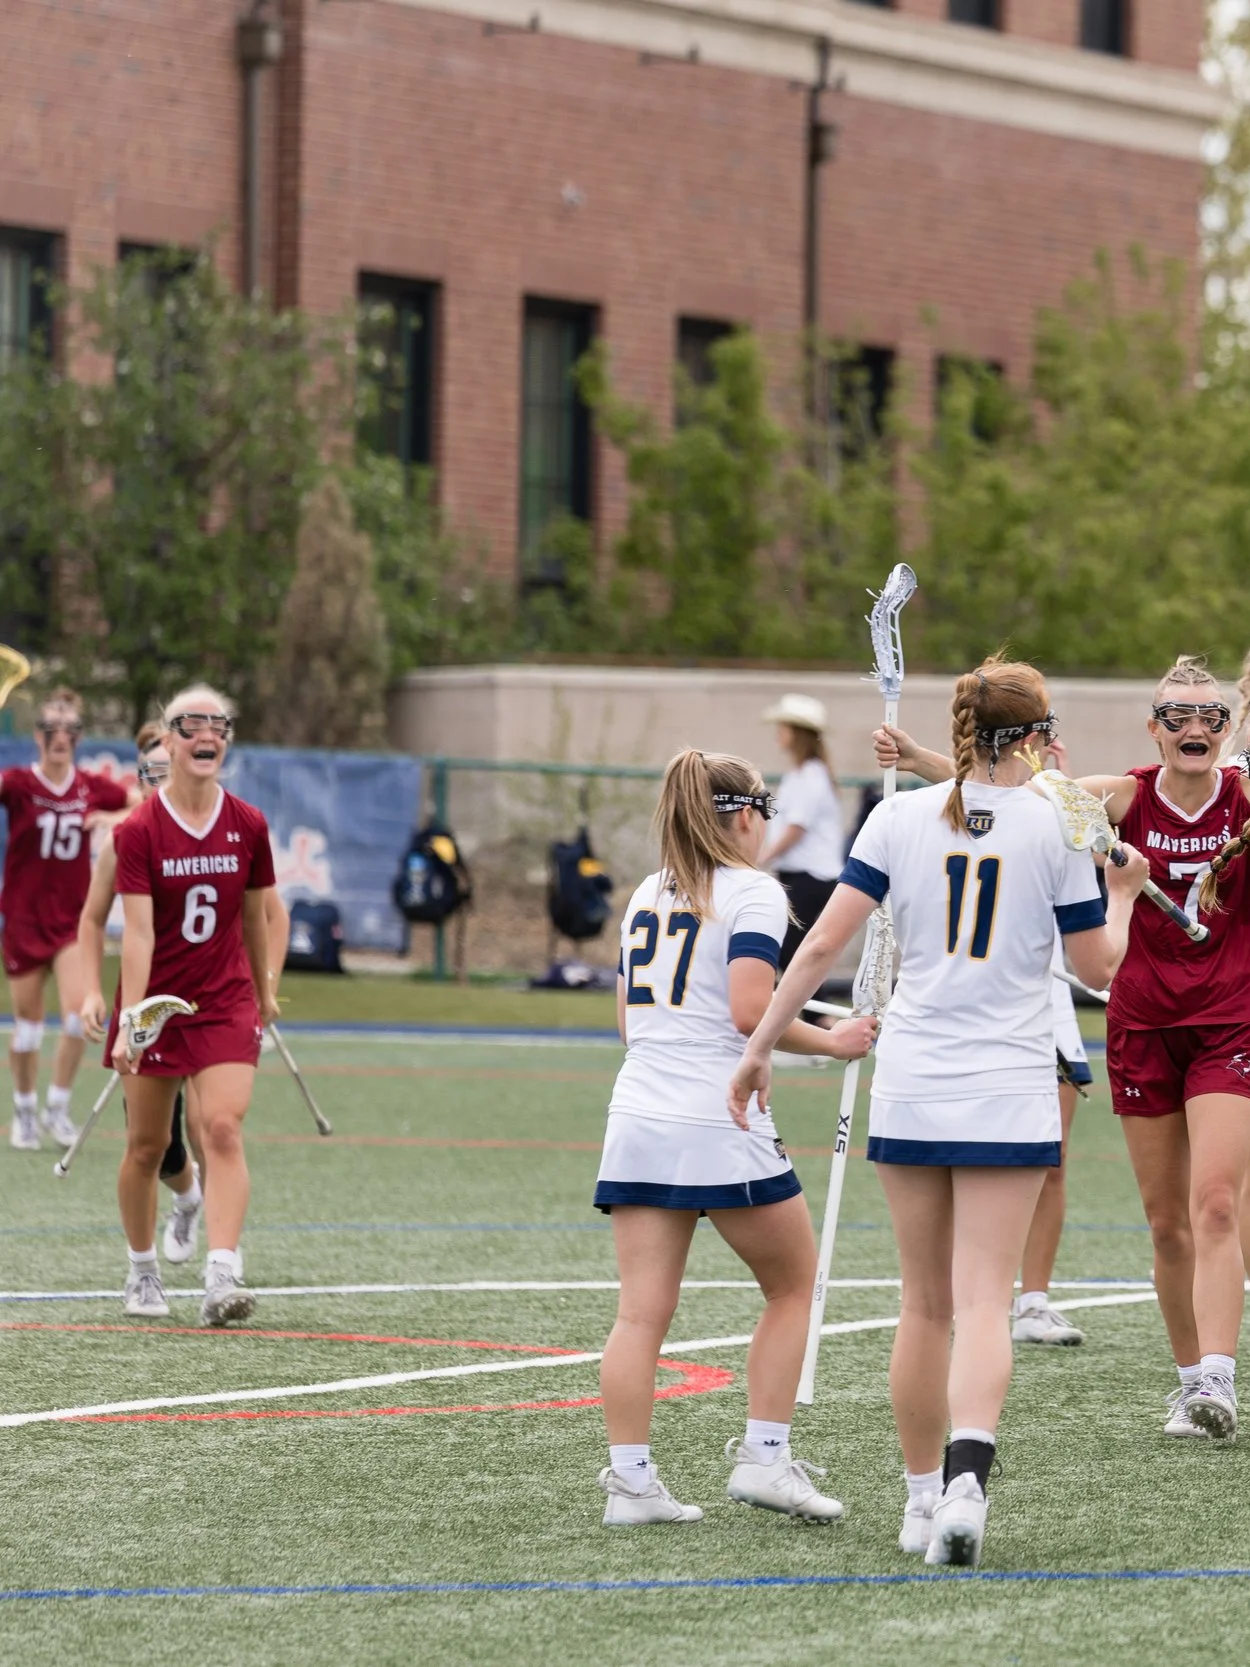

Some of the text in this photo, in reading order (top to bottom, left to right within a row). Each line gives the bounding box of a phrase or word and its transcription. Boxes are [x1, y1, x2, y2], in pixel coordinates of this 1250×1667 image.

[996, 726, 1025, 737] STX
[36, 811, 83, 861] 15
[162, 854, 240, 877] MAVERICKS
[1169, 861, 1212, 924] 7
[181, 883, 218, 944] 6
[944, 851, 1002, 962] 11
[626, 907, 704, 1009] 27
[835, 1114, 850, 1156] STX
